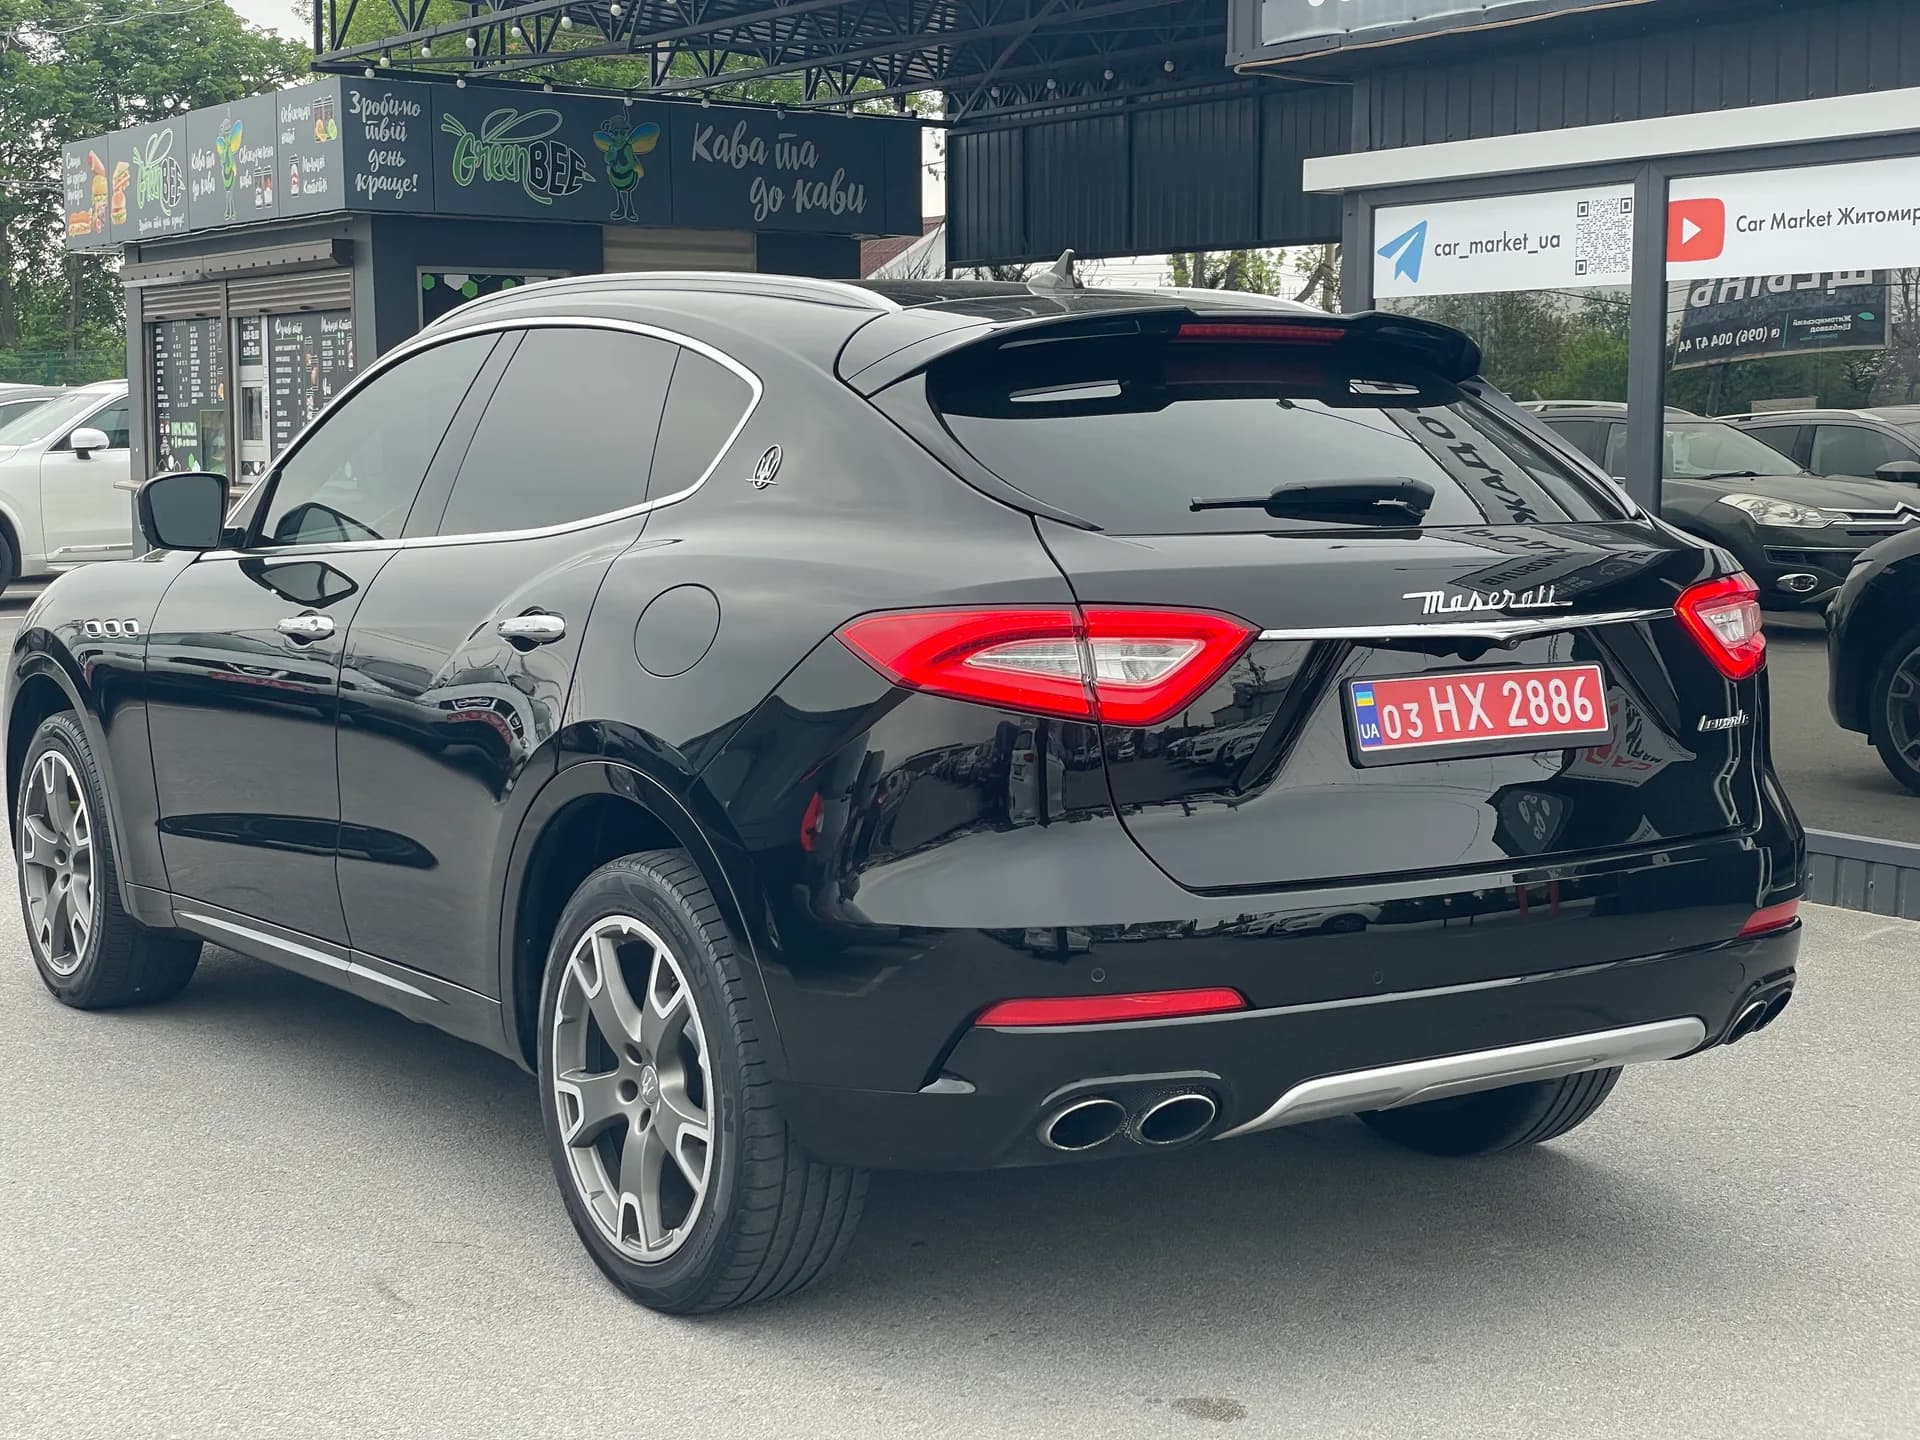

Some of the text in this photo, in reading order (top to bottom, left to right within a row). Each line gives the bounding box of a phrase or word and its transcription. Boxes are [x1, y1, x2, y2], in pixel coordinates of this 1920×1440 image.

[349, 91, 421, 123] Зробимо
[365, 117, 407, 142] твій
[692, 120, 819, 170] Кава та
[368, 148, 407, 173] день
[355, 173, 418, 201] краще!
[750, 168, 867, 222] до кави
[1736, 206, 1920, 233] Car Market Житомир
[1434, 231, 1561, 259] car_market_ua
[1403, 584, 1574, 615] Maserati
[1382, 676, 1594, 740] 03 HX 2886
[1360, 723, 1381, 740] UA
